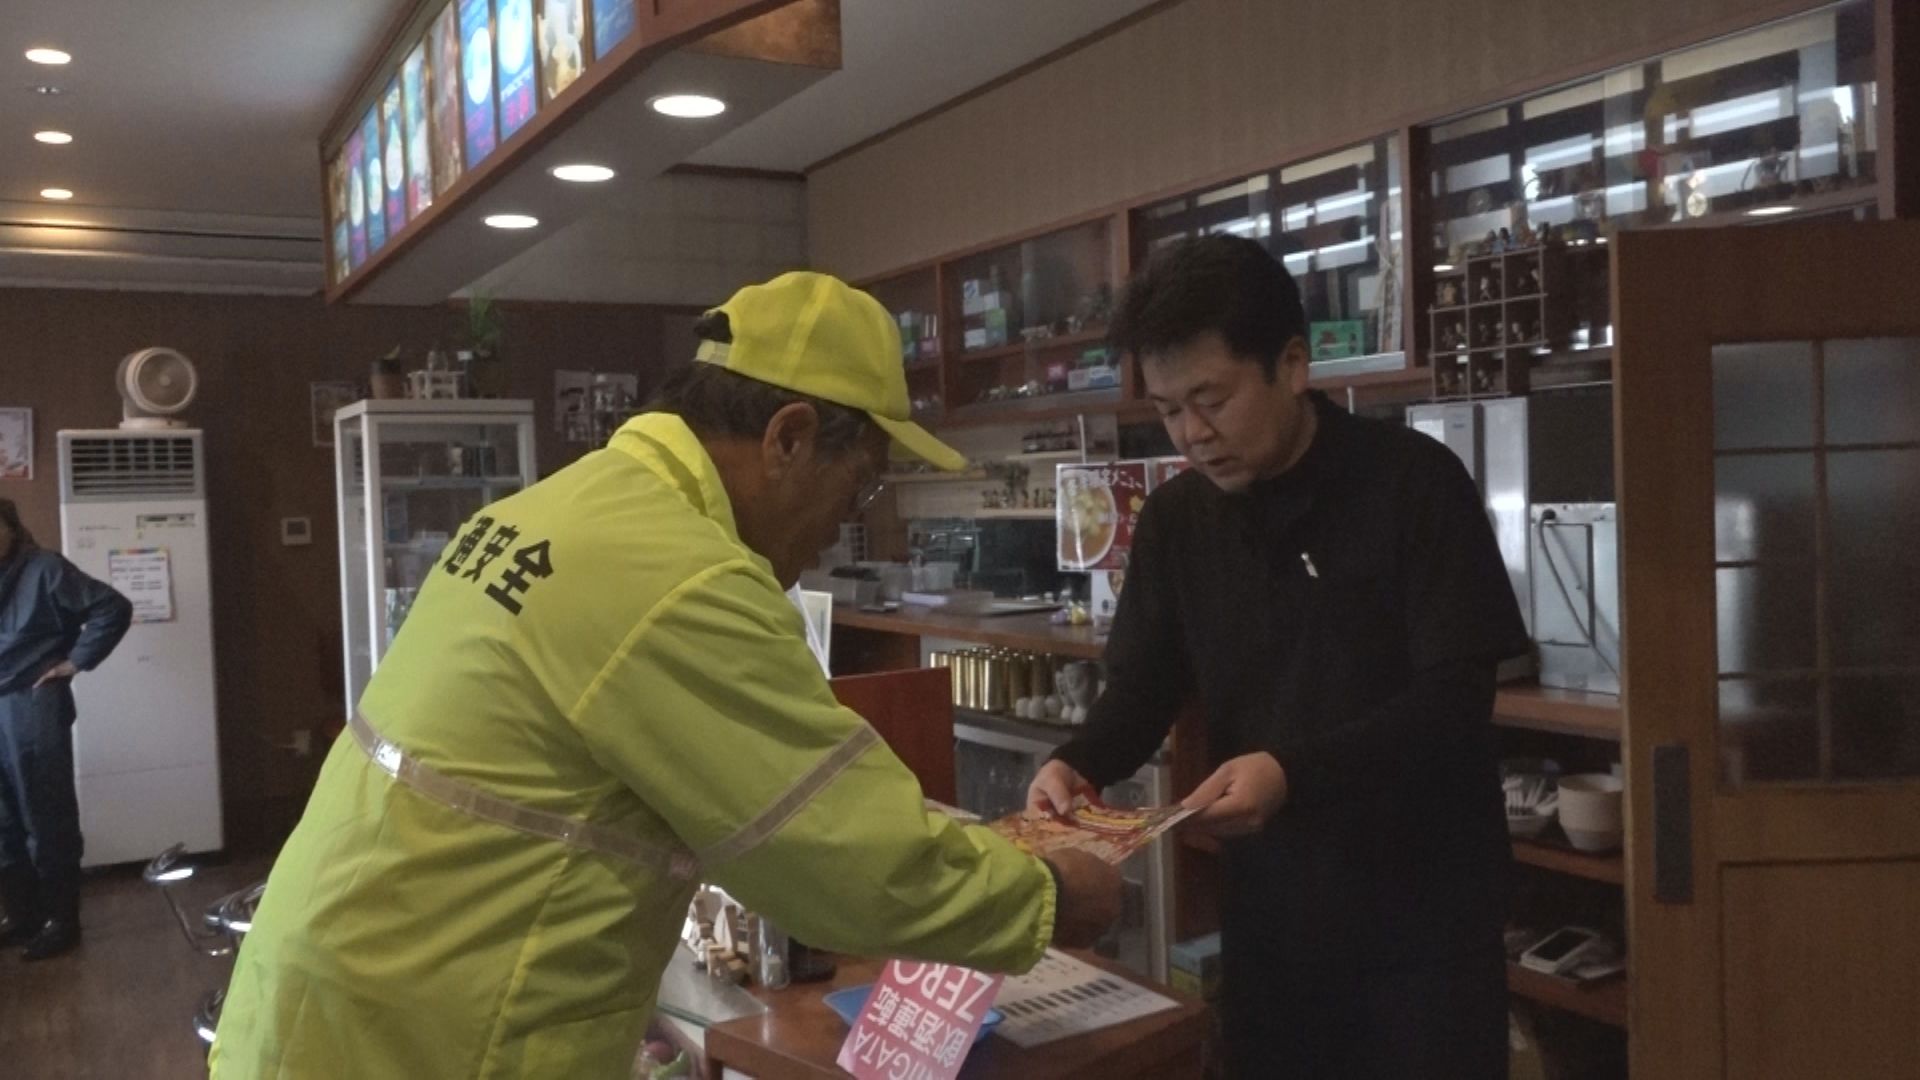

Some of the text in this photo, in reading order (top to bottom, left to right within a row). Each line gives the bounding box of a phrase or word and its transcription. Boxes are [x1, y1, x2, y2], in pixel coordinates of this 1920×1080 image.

[866, 983, 969, 1069] 飲酒運転
[893, 958, 995, 1024] ZERO
